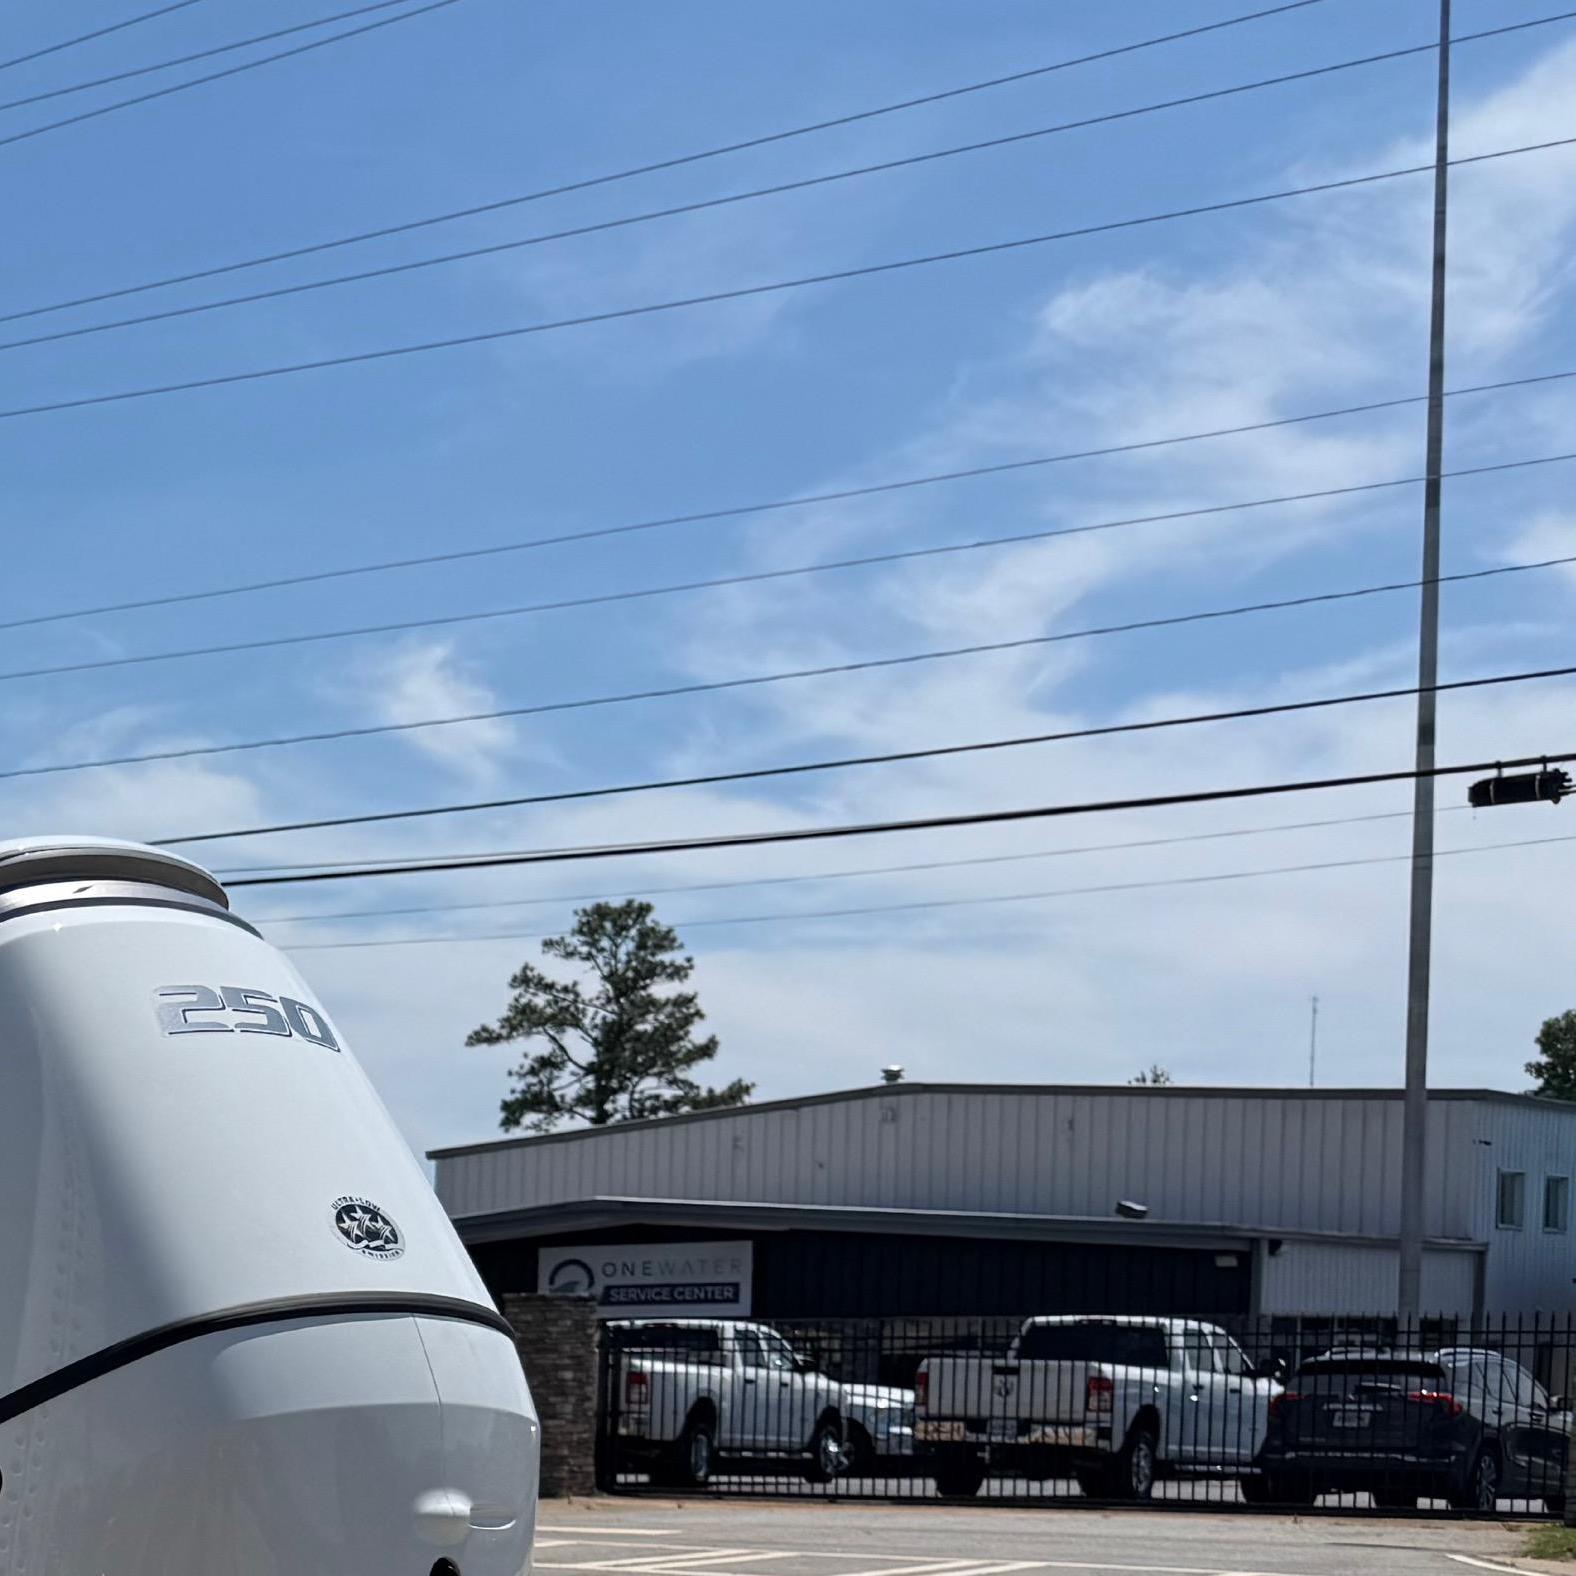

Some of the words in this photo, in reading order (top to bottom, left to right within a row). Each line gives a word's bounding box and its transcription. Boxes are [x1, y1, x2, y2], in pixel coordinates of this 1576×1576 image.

[154, 984, 341, 1052] 250
[610, 1287, 671, 1301] SERVICE
[674, 1286, 734, 1300] CENTER
